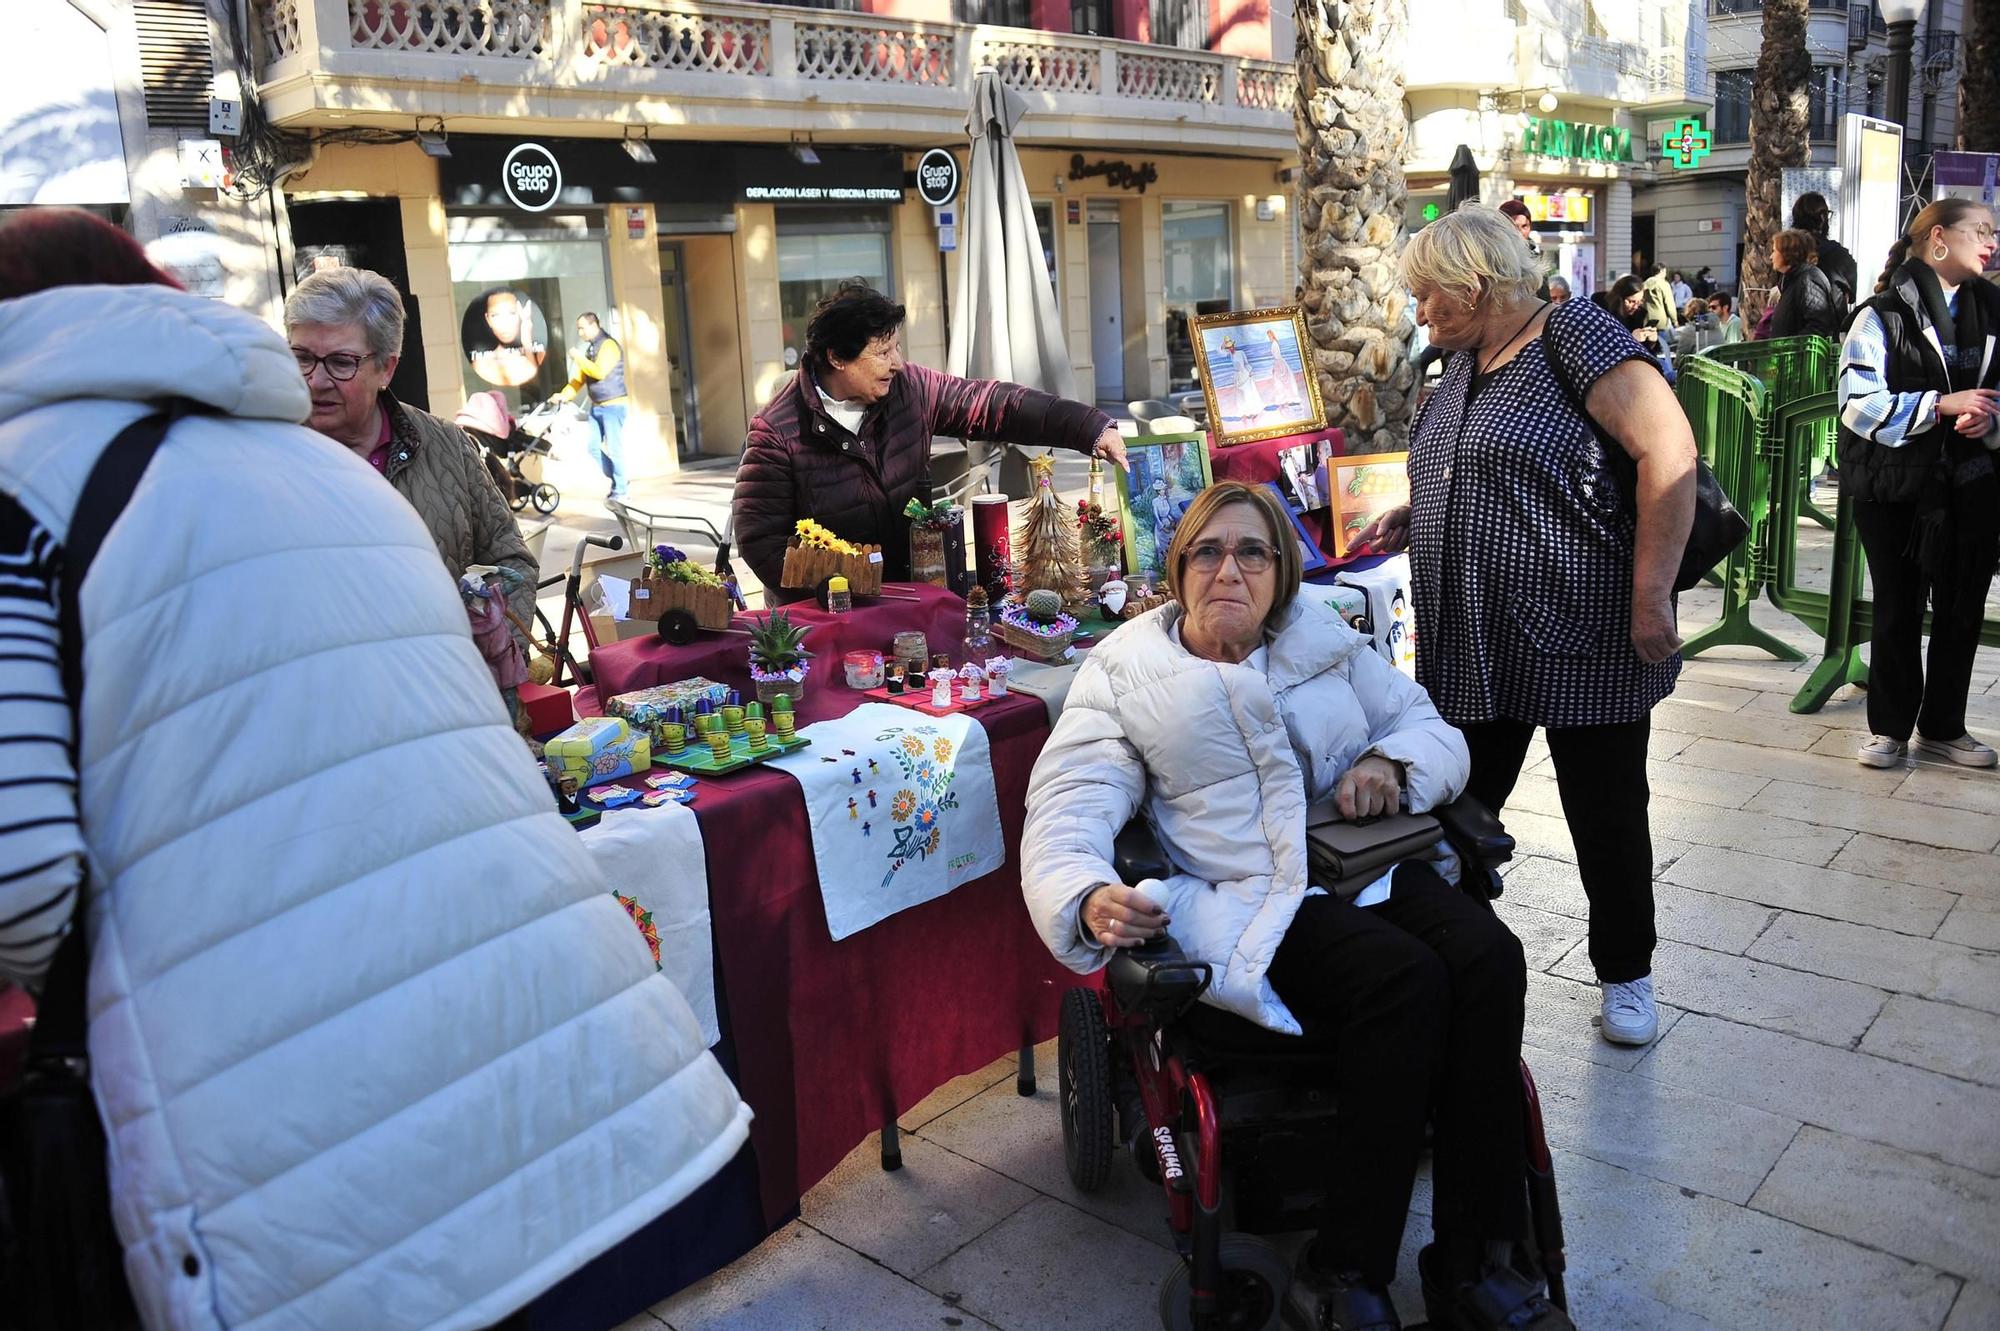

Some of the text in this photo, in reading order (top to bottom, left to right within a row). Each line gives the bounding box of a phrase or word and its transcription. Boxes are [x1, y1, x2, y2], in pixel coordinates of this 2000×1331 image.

[1523, 117, 1633, 162] FARMACIA
[510, 161, 553, 179] Grupo
[922, 164, 952, 180] Grupo
[516, 175, 549, 194] stop
[746, 186, 901, 199] DEPILACIÓN LÁSER Y MEDICINA ESTÉTICA
[925, 177, 949, 190] stop
[1153, 1126, 1184, 1179] SPRING
